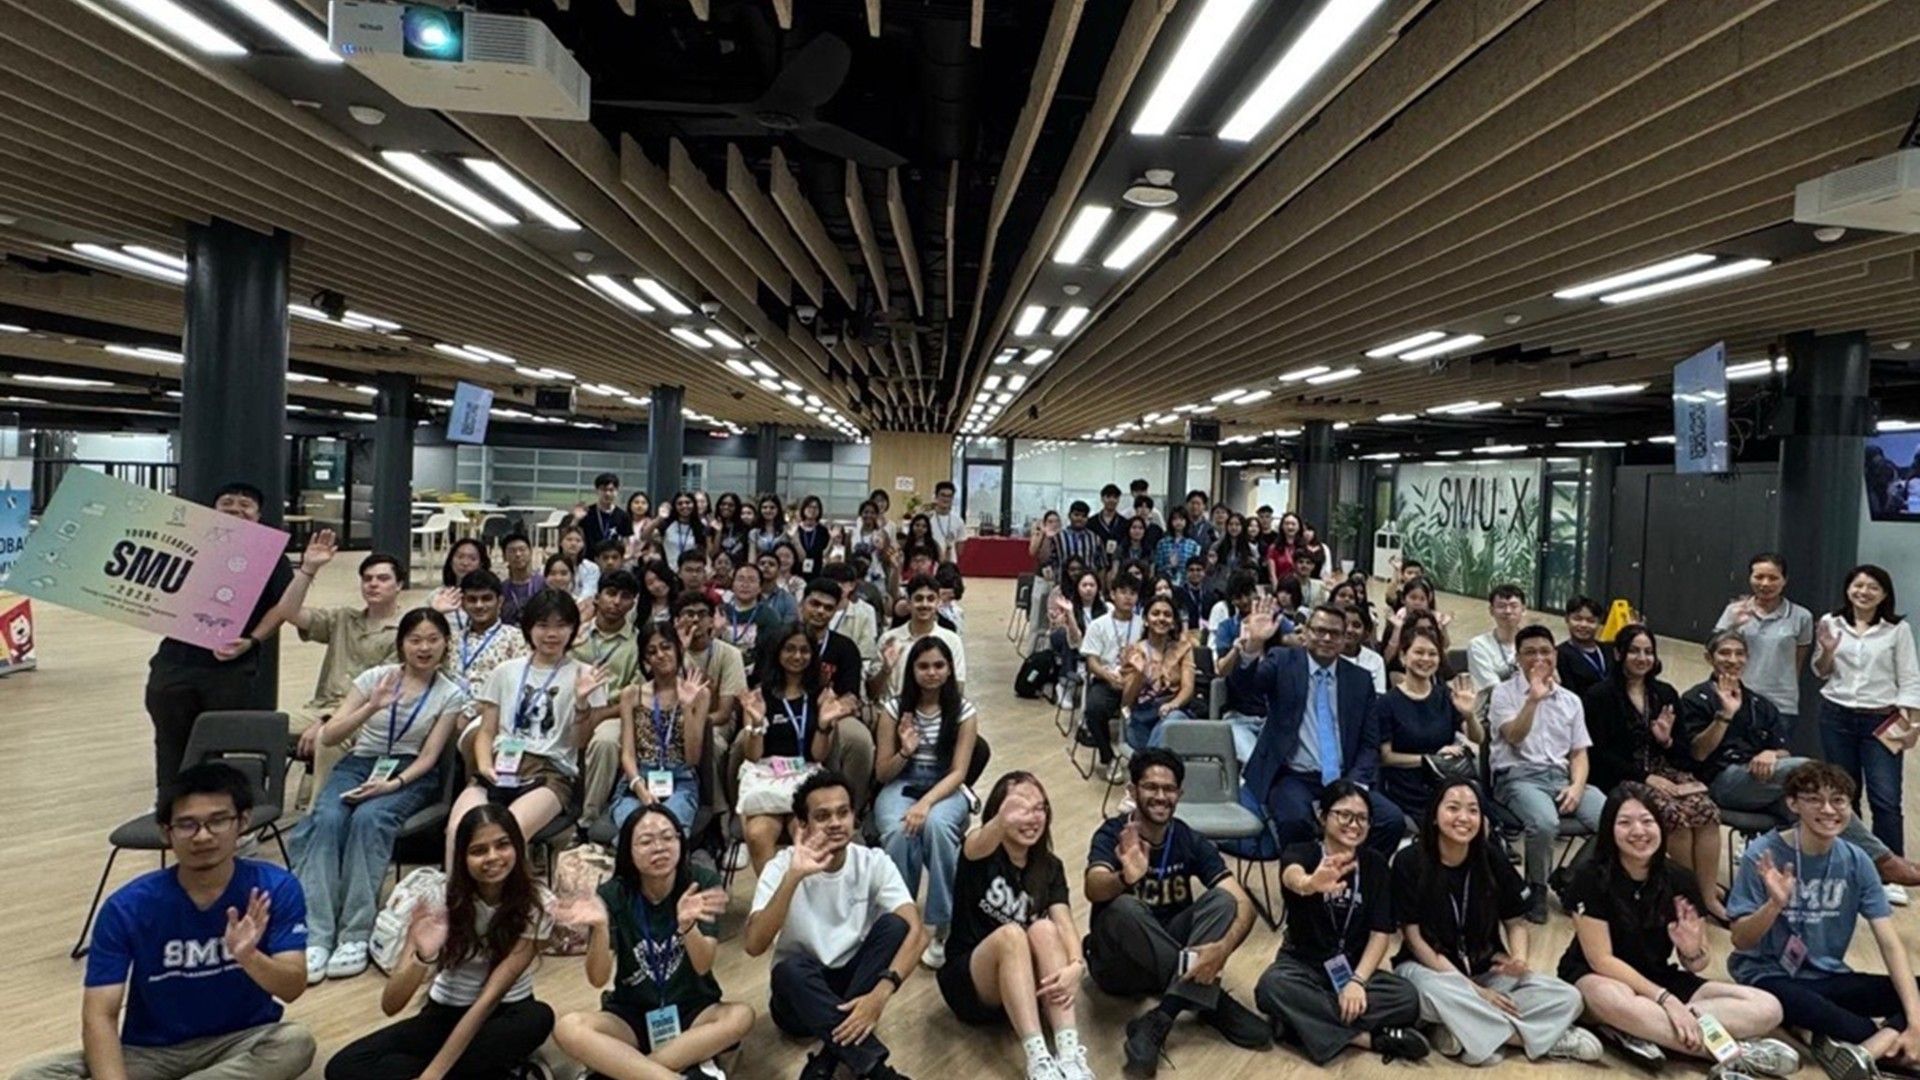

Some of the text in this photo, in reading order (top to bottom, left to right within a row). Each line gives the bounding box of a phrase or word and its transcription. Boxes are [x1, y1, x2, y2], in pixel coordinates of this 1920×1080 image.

[1438, 477, 1530, 534] SMU-X
[103, 540, 194, 594] SMU
[125, 528, 199, 558] YOUNG LEADERS
[985, 875, 1034, 923] SM
[1788, 878, 1848, 910] MU
